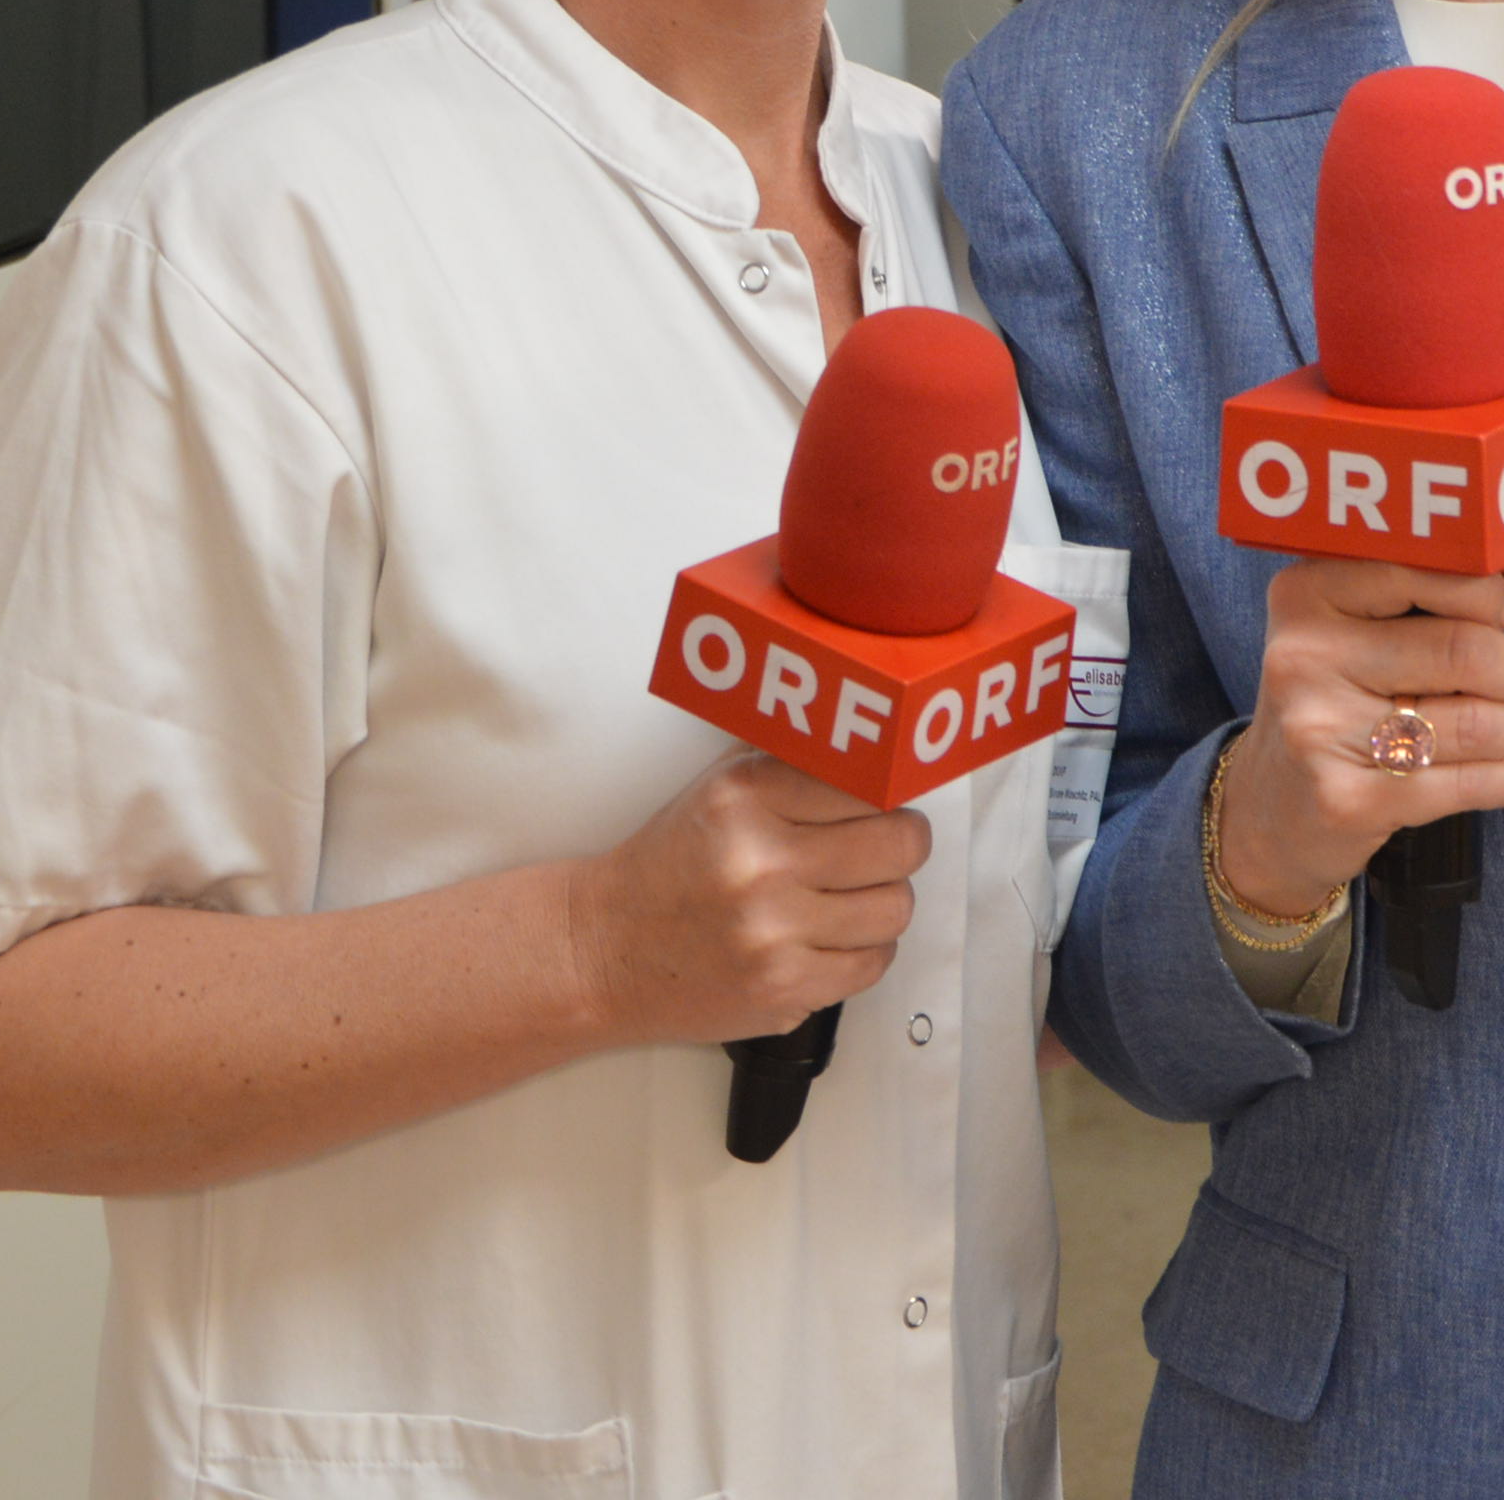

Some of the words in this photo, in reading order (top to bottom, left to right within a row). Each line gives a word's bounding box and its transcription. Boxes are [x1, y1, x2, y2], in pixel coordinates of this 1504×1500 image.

[931, 437, 1018, 494] ORF
[1238, 440, 1468, 538] ORF
[682, 613, 893, 753] ORF
[913, 632, 1069, 763] ORF
